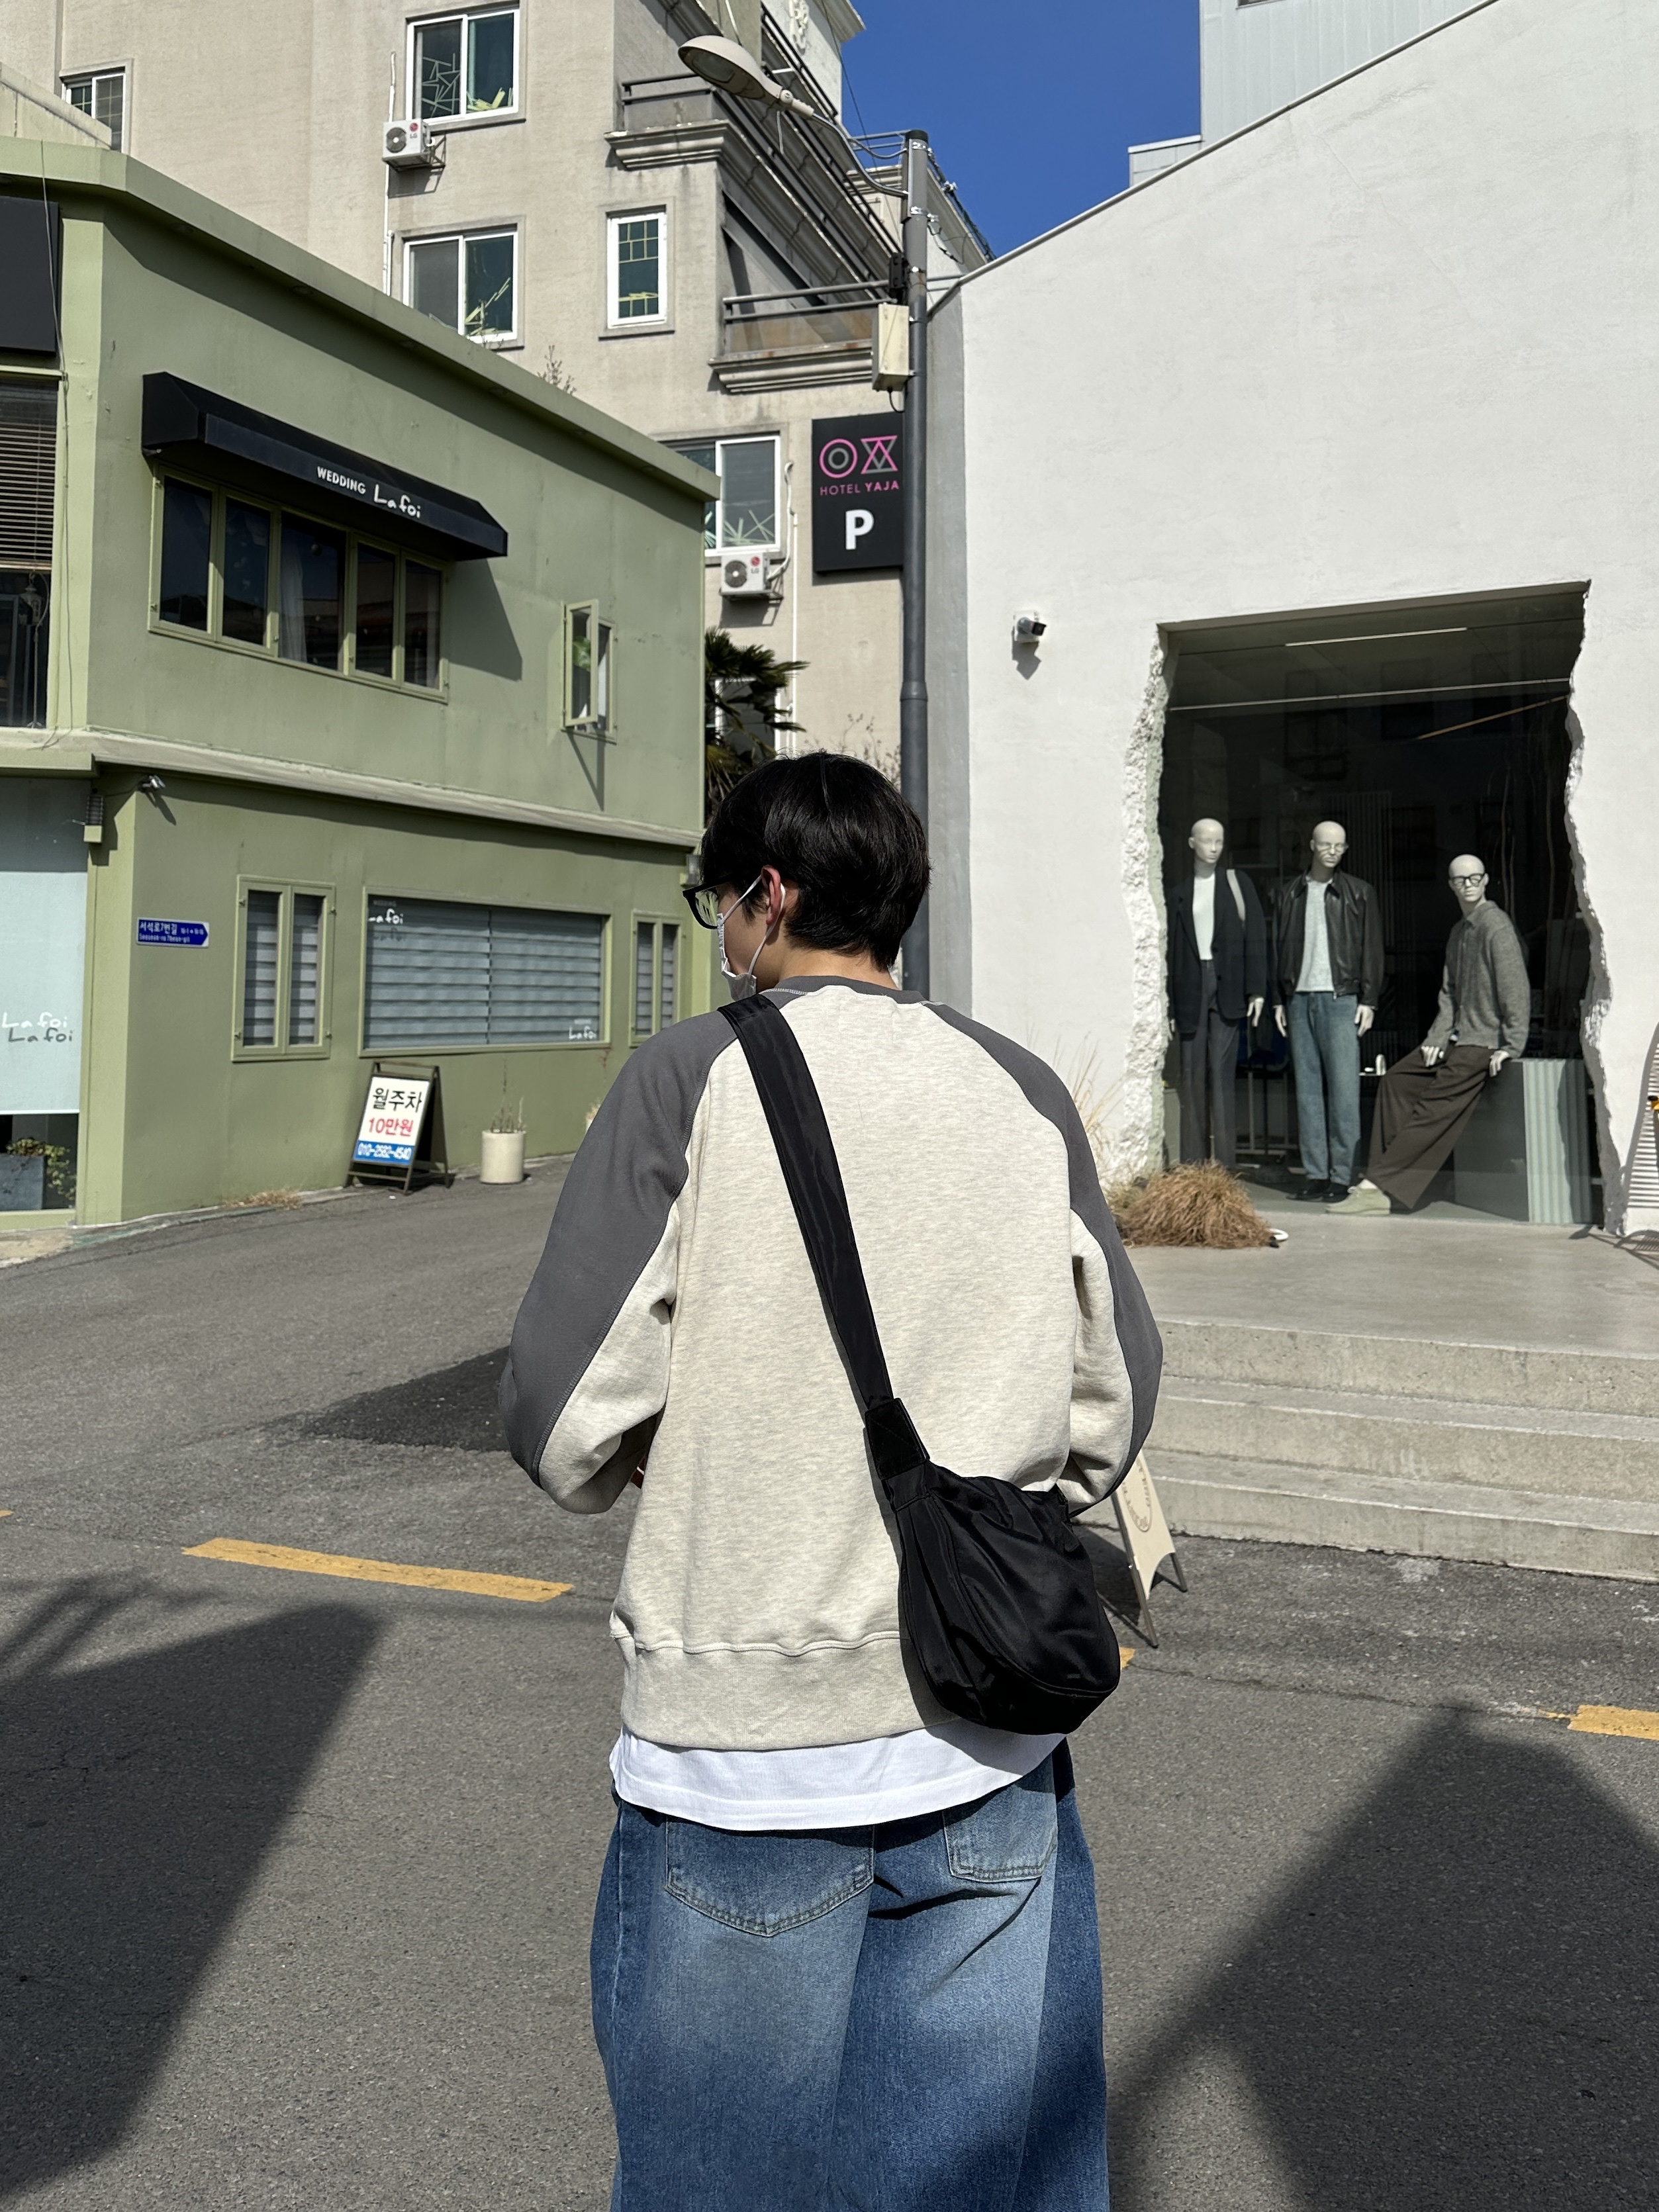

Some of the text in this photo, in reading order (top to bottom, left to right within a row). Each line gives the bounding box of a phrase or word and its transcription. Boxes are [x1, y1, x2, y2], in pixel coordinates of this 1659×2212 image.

[317, 466, 366, 494] WEDDING
[820, 481, 900, 496] HOTEL YAJA
[845, 509, 875, 550] P
[372, 1087, 422, 1113] 월주차
[369, 1117, 414, 1137] 10만원
